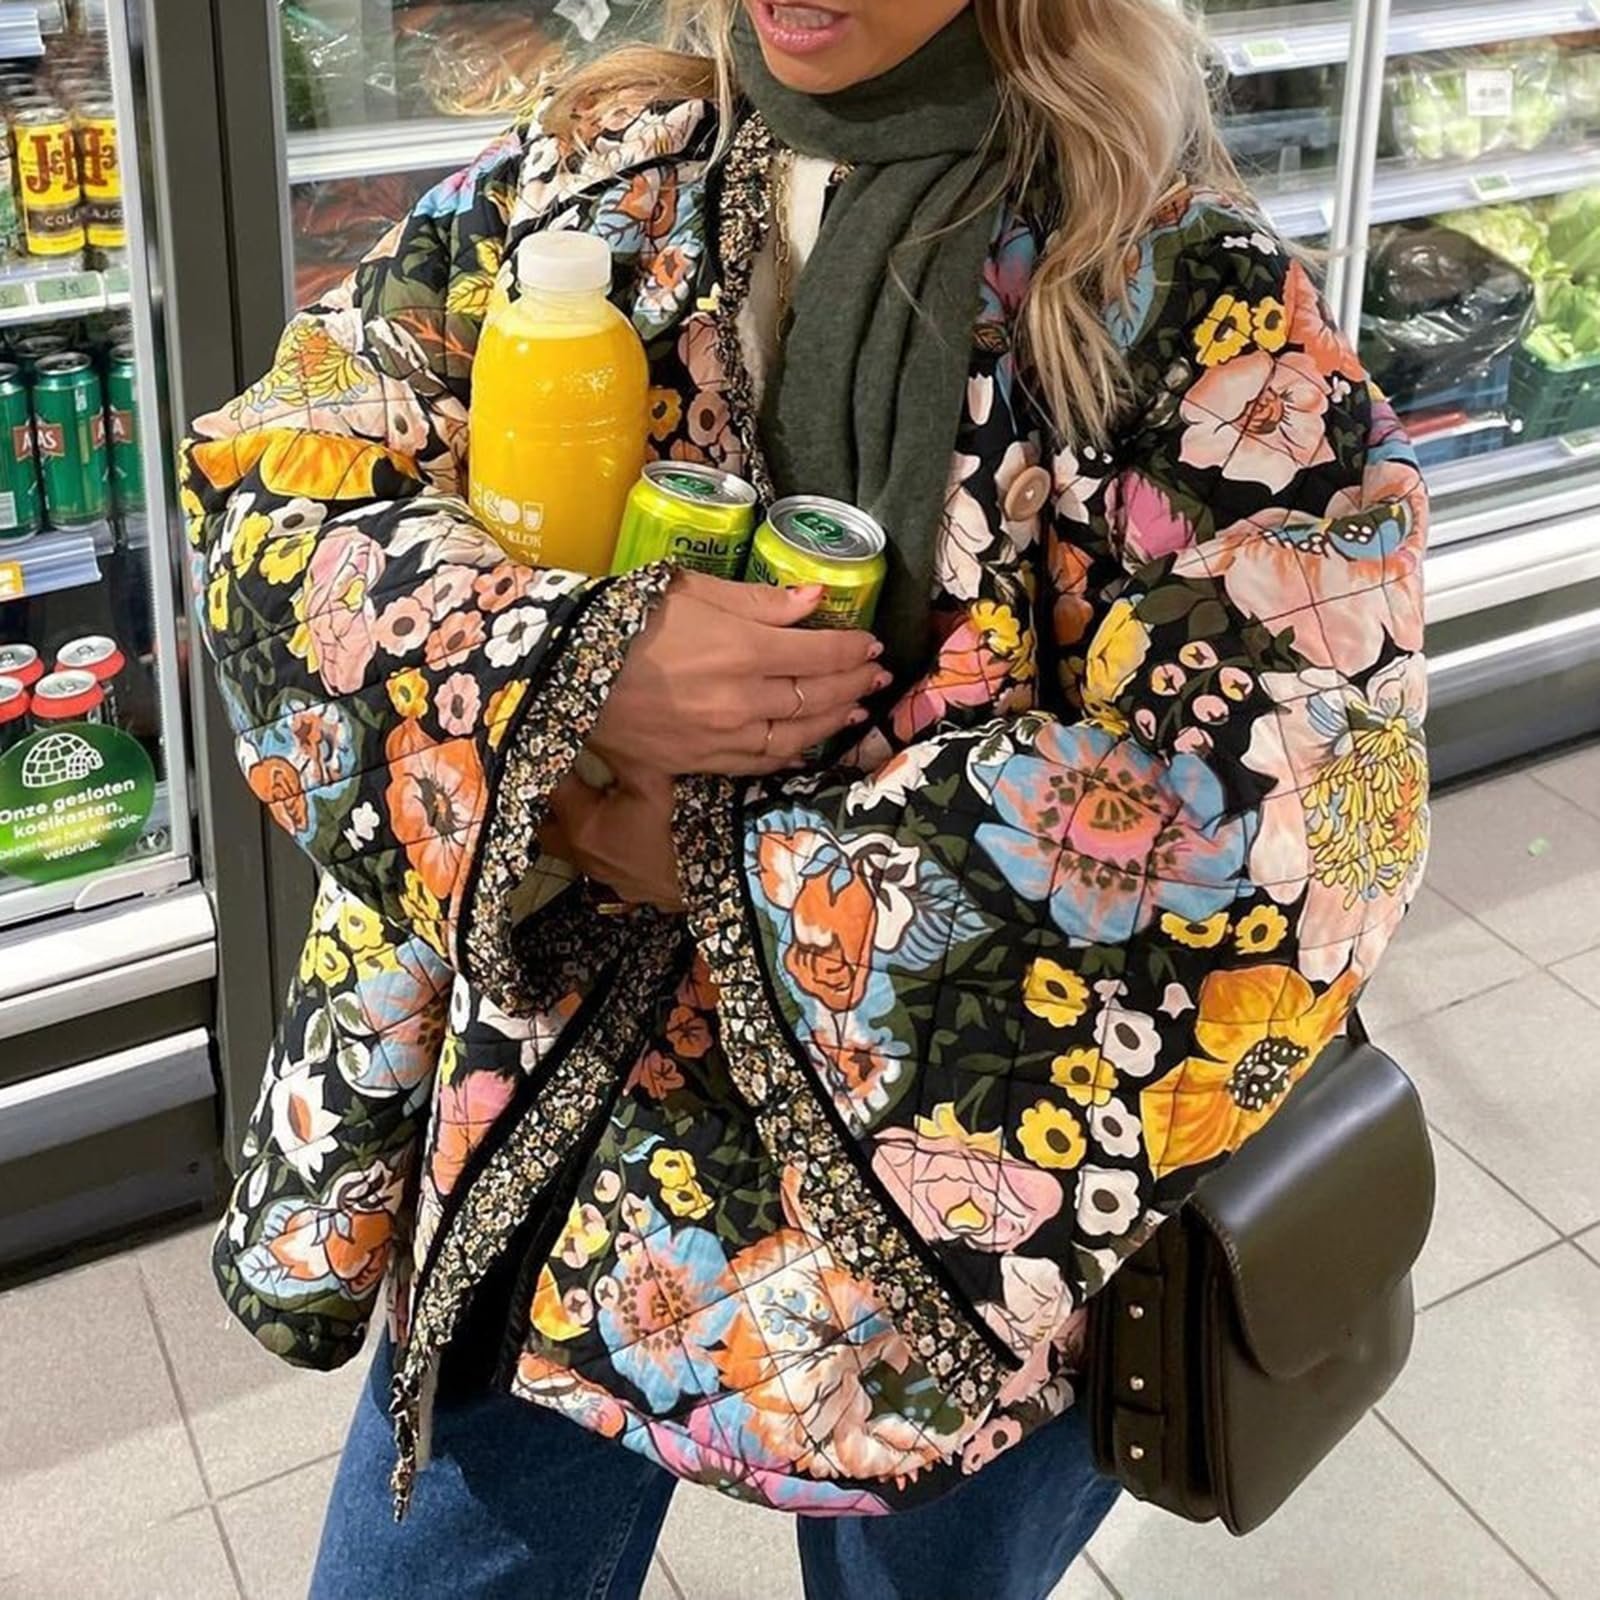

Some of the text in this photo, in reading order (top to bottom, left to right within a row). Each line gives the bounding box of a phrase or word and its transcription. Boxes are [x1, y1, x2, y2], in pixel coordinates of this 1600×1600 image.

[675, 537, 728, 555] nalu
[0, 779, 136, 824] Onze gesloten
[13, 801, 124, 839] koelkasten,
[42, 840, 101, 861] verbruik.
